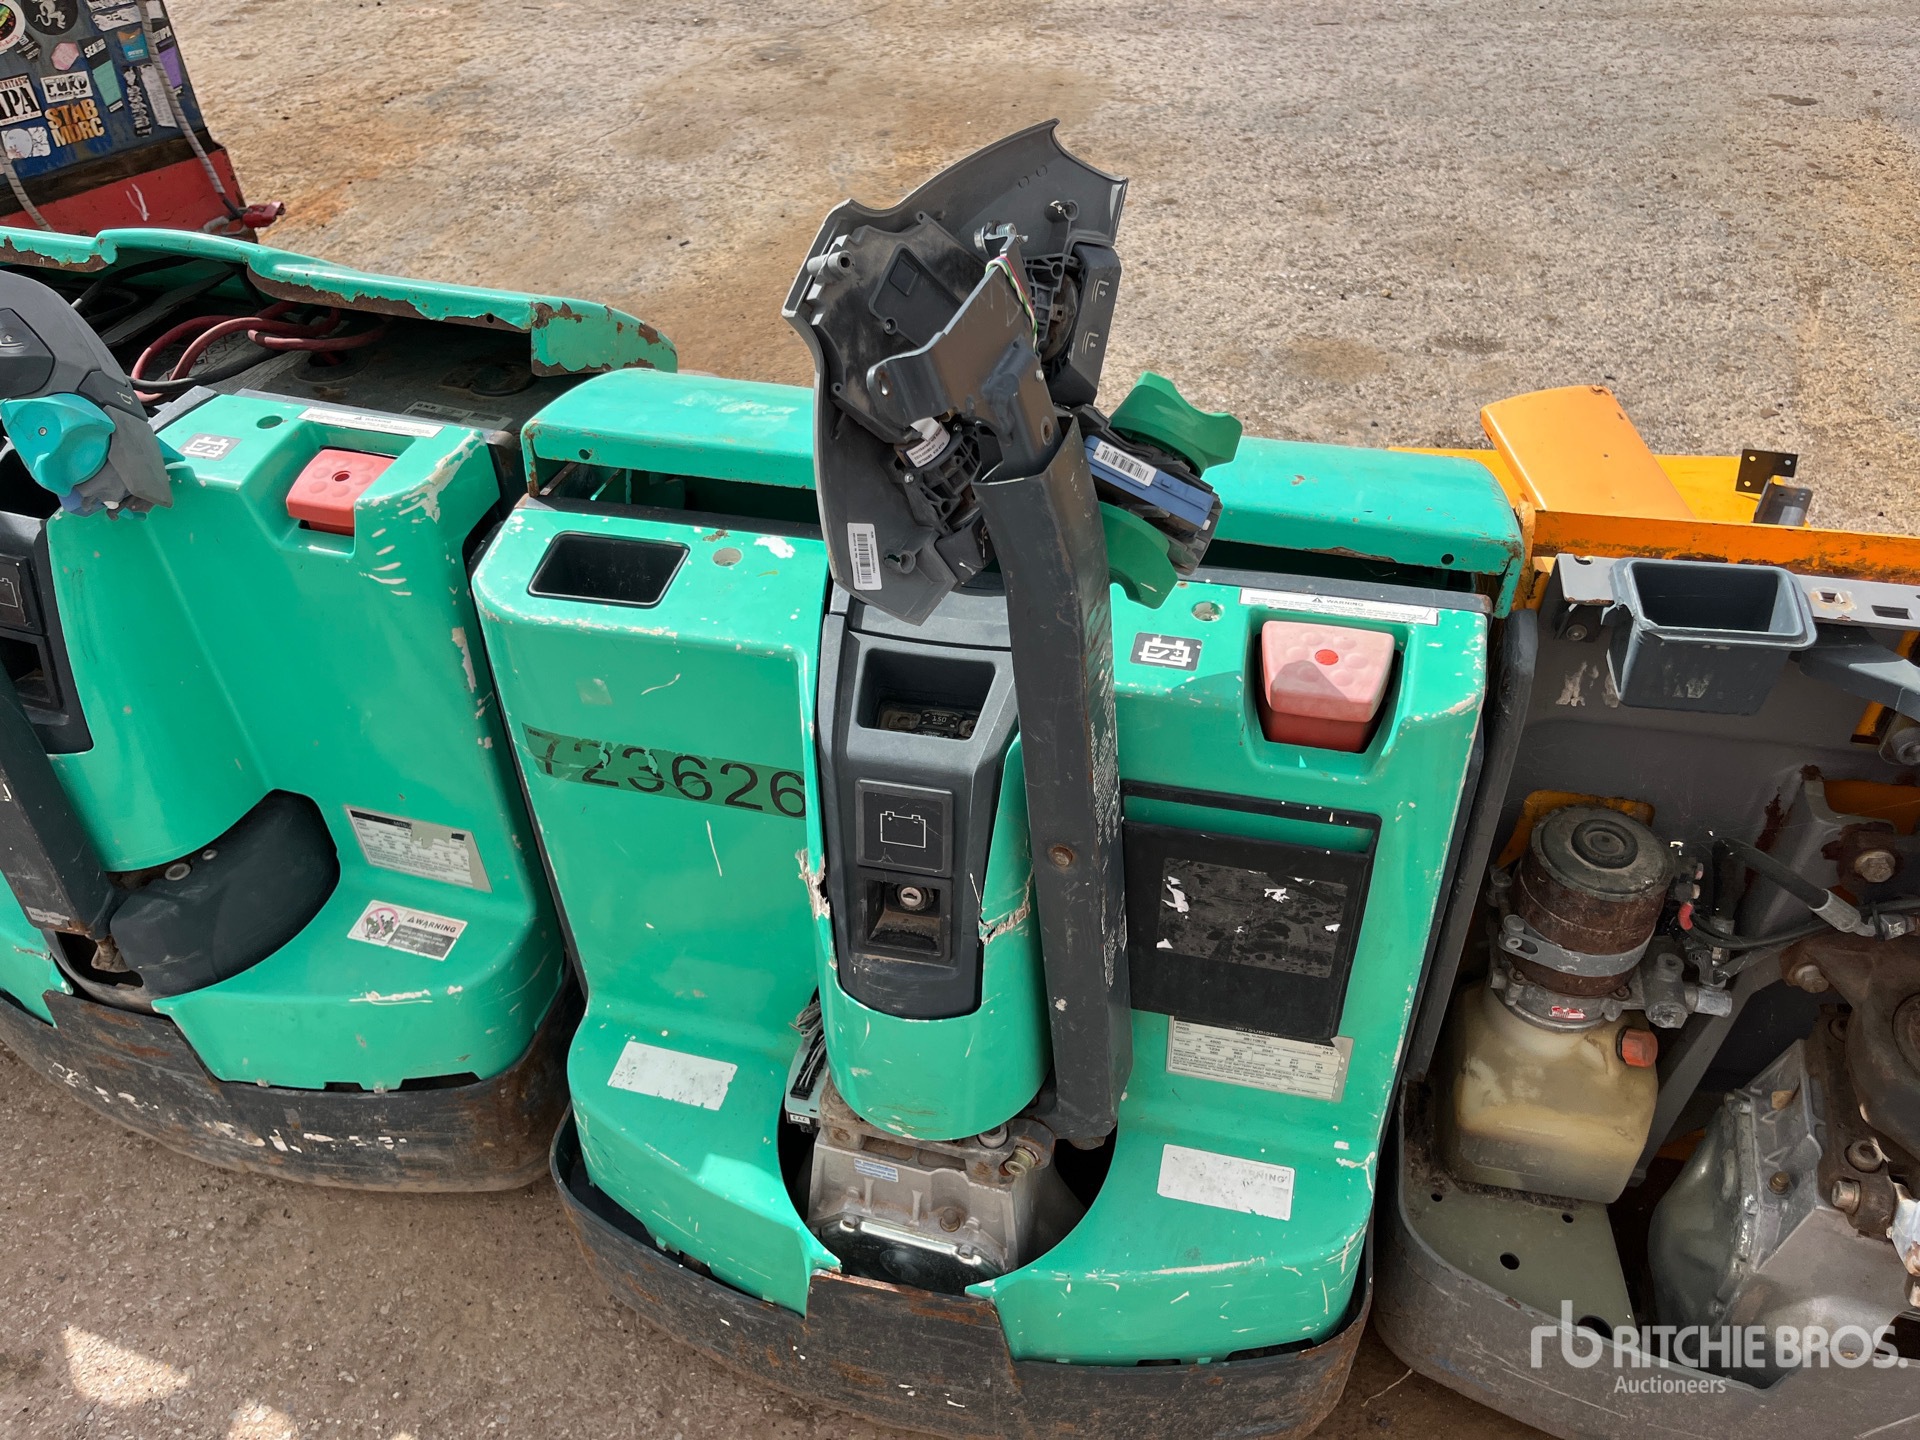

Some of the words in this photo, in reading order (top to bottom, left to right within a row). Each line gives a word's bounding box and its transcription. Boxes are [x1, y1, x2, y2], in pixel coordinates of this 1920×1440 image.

[45, 98, 98, 129] STAB
[51, 117, 105, 148] MDRC
[1326, 599, 1364, 607] WARNING
[527, 727, 806, 818] 723626
[415, 919, 457, 933] WARNING
